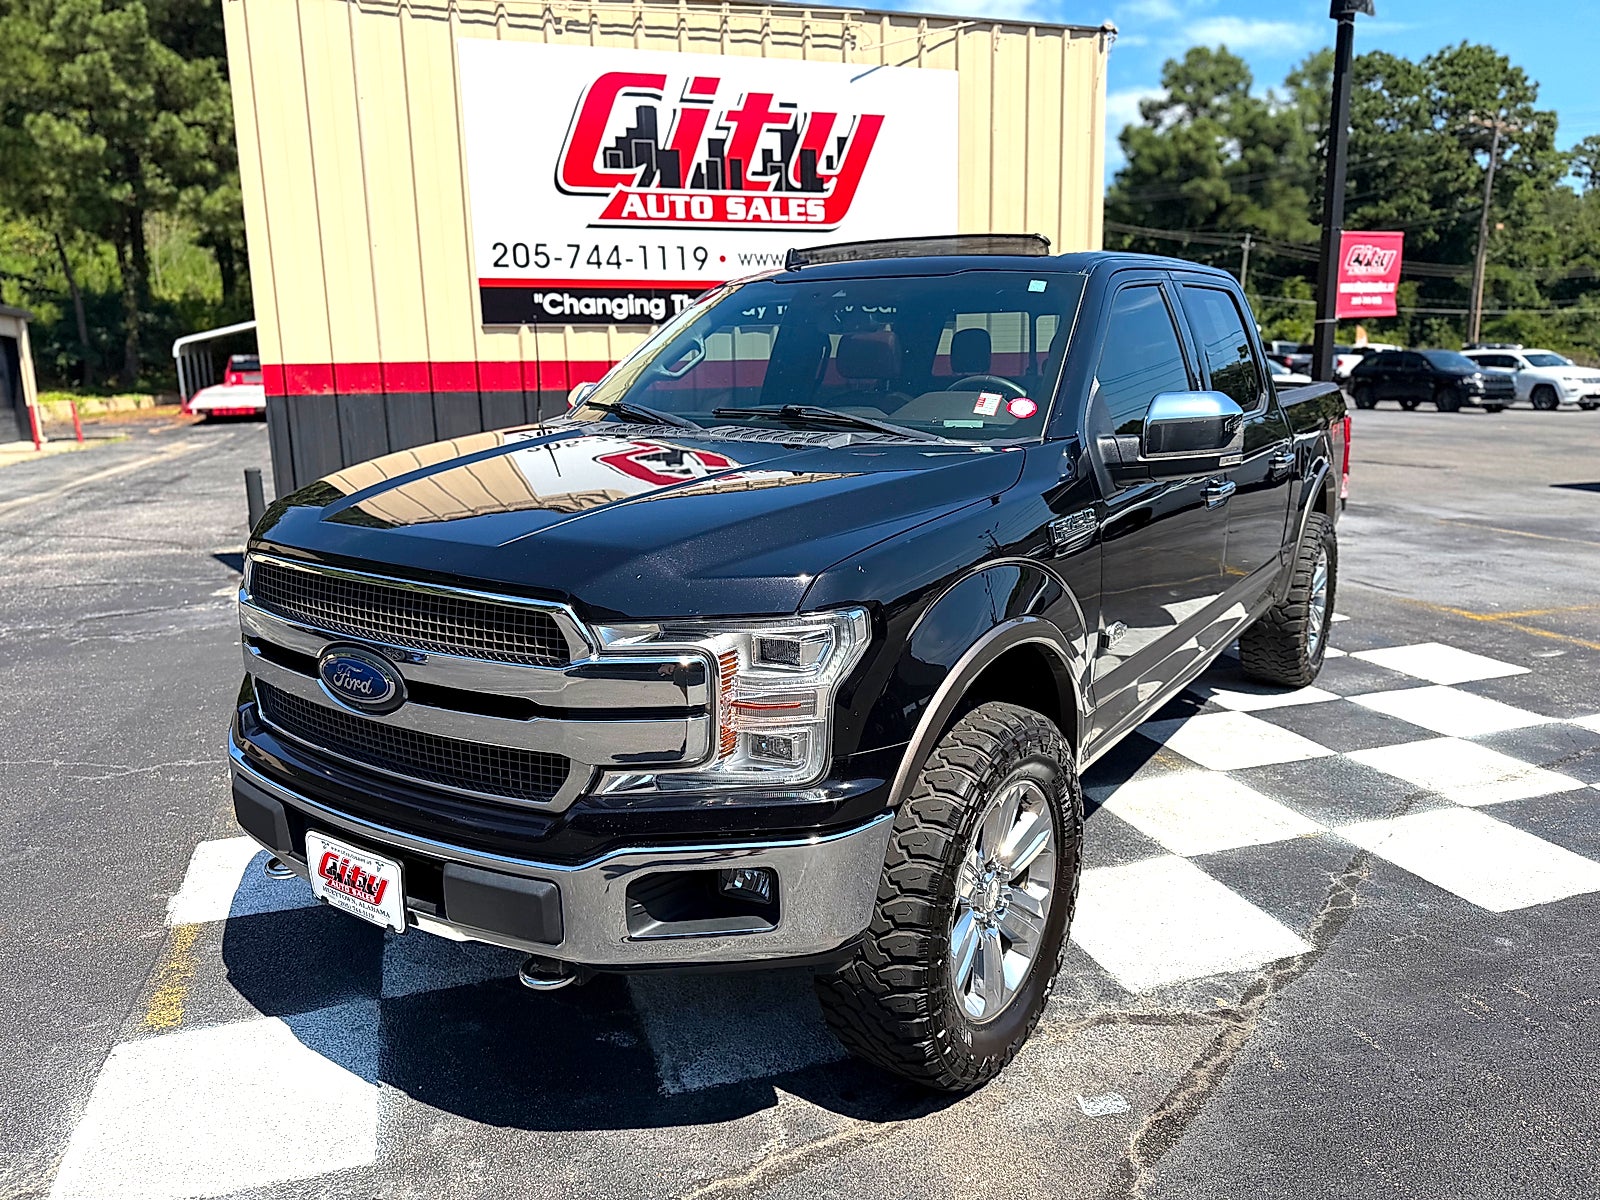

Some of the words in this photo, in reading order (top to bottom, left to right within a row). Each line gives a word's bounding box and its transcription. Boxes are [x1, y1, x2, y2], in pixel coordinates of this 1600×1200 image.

[556, 71, 885, 222] City
[621, 193, 714, 219] AUTO
[726, 196, 826, 222] SALES
[492, 242, 709, 271] 205-744-1119
[333, 663, 374, 694] Ford
[318, 851, 389, 906] City
